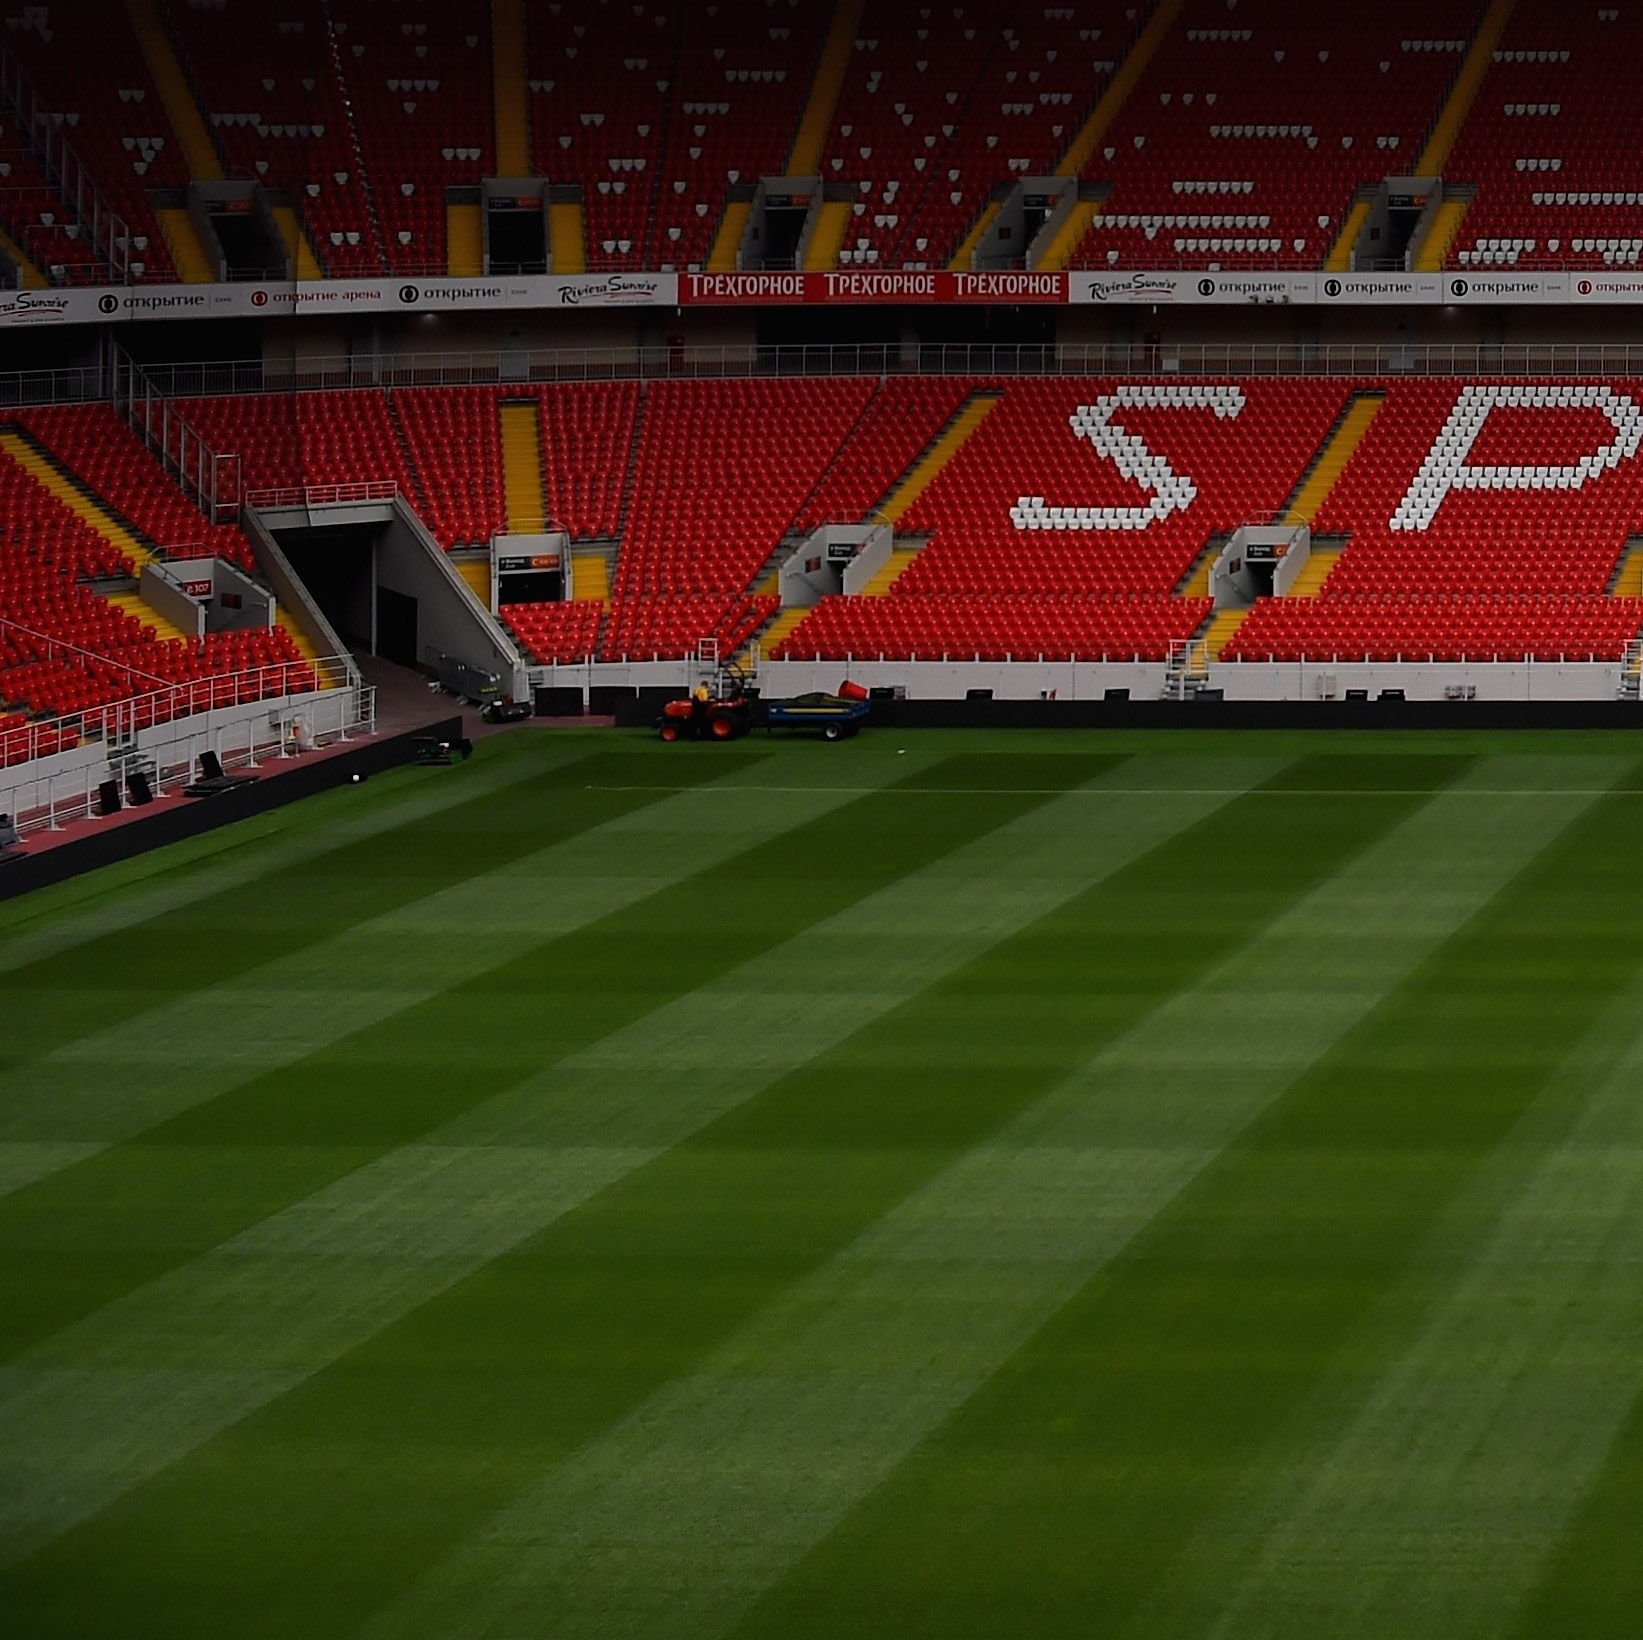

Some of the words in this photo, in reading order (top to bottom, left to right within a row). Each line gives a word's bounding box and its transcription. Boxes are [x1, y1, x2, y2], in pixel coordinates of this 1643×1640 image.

[558, 284, 607, 304] Riviera
[607, 275, 658, 291] Sunrise
[1089, 282, 1132, 300] Riviera
[1132, 274, 1177, 290] Sunrise
[1219, 283, 1286, 295] открытие
[1345, 283, 1412, 296] открытие
[1472, 283, 1539, 296] открытие
[16, 292, 69, 309] Sunrise
[343, 291, 381, 302] арена
[424, 288, 502, 302] открытие
[124, 295, 205, 310] открытие
